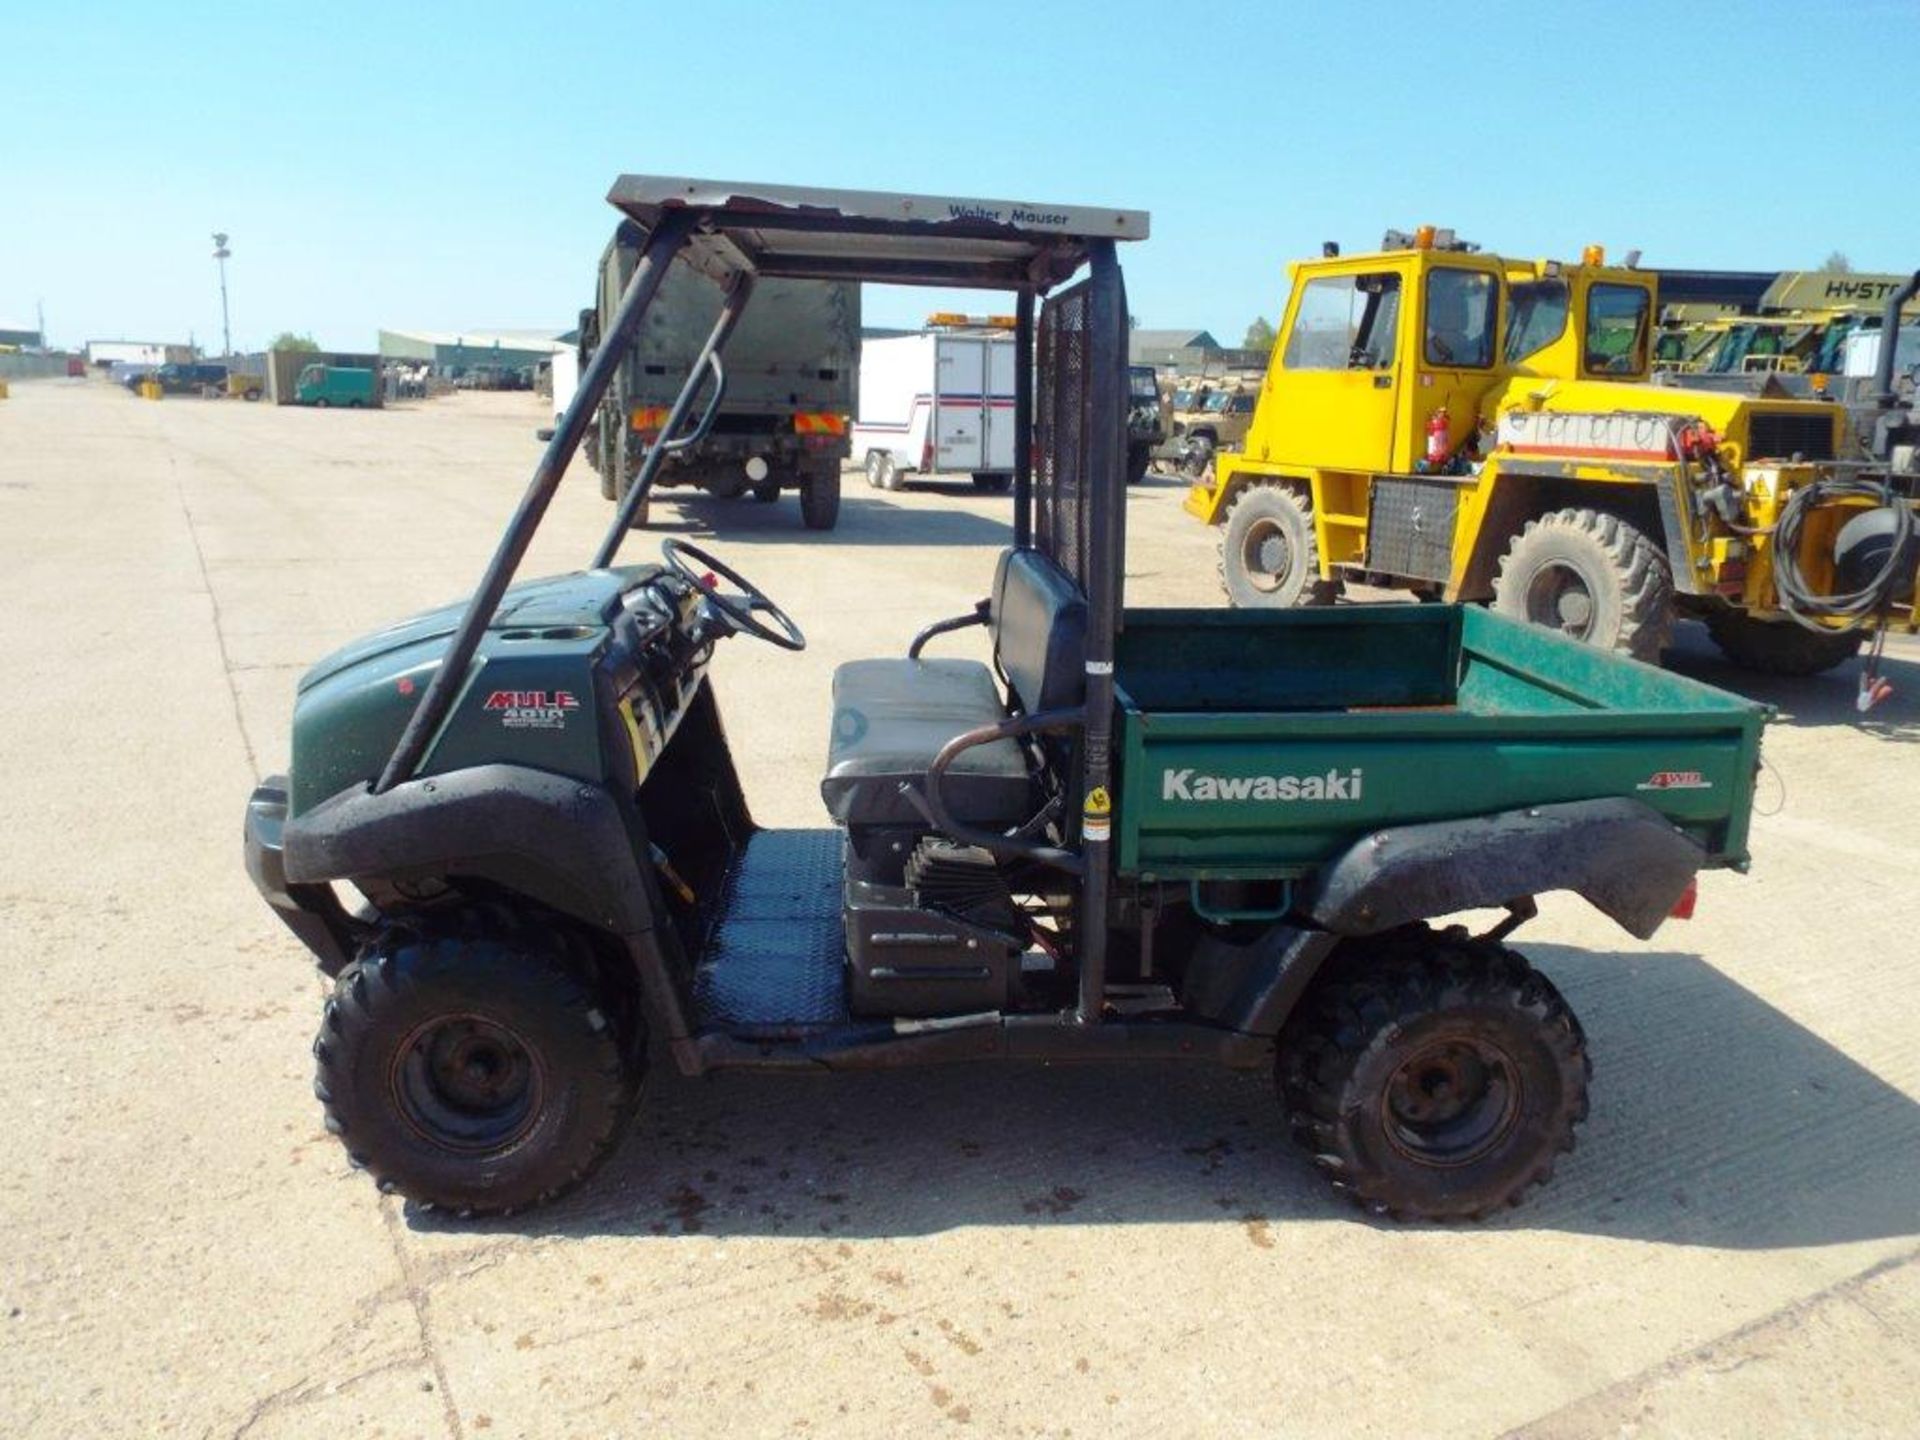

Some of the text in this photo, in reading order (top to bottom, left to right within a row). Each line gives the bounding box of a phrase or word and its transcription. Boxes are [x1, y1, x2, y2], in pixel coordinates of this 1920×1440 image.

[949, 204, 1070, 225] Walter Mauser
[1825, 280, 1917, 301] HYST
[483, 691, 580, 711] MULE
[1163, 768, 1363, 801] Kawasaki
